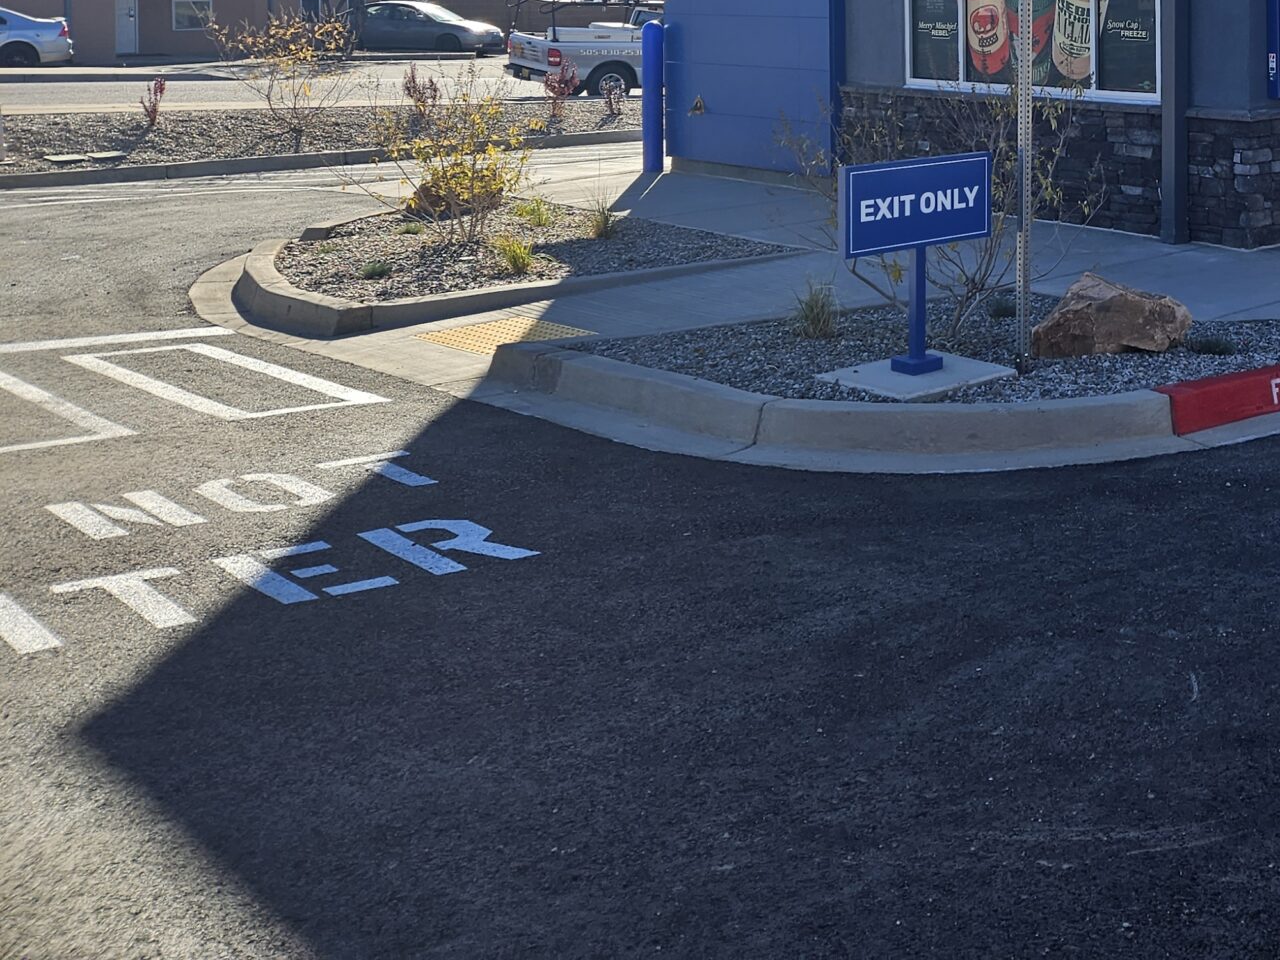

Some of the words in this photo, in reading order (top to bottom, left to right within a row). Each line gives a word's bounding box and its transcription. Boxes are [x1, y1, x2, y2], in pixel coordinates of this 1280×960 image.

[1125, 20, 1139, 30] Cap
[931, 29, 949, 37] REBEL
[1120, 30, 1147, 38] FREEZE
[860, 194, 915, 223] EXIT
[919, 185, 980, 214] ONLY
[44, 450, 439, 540] NOT
